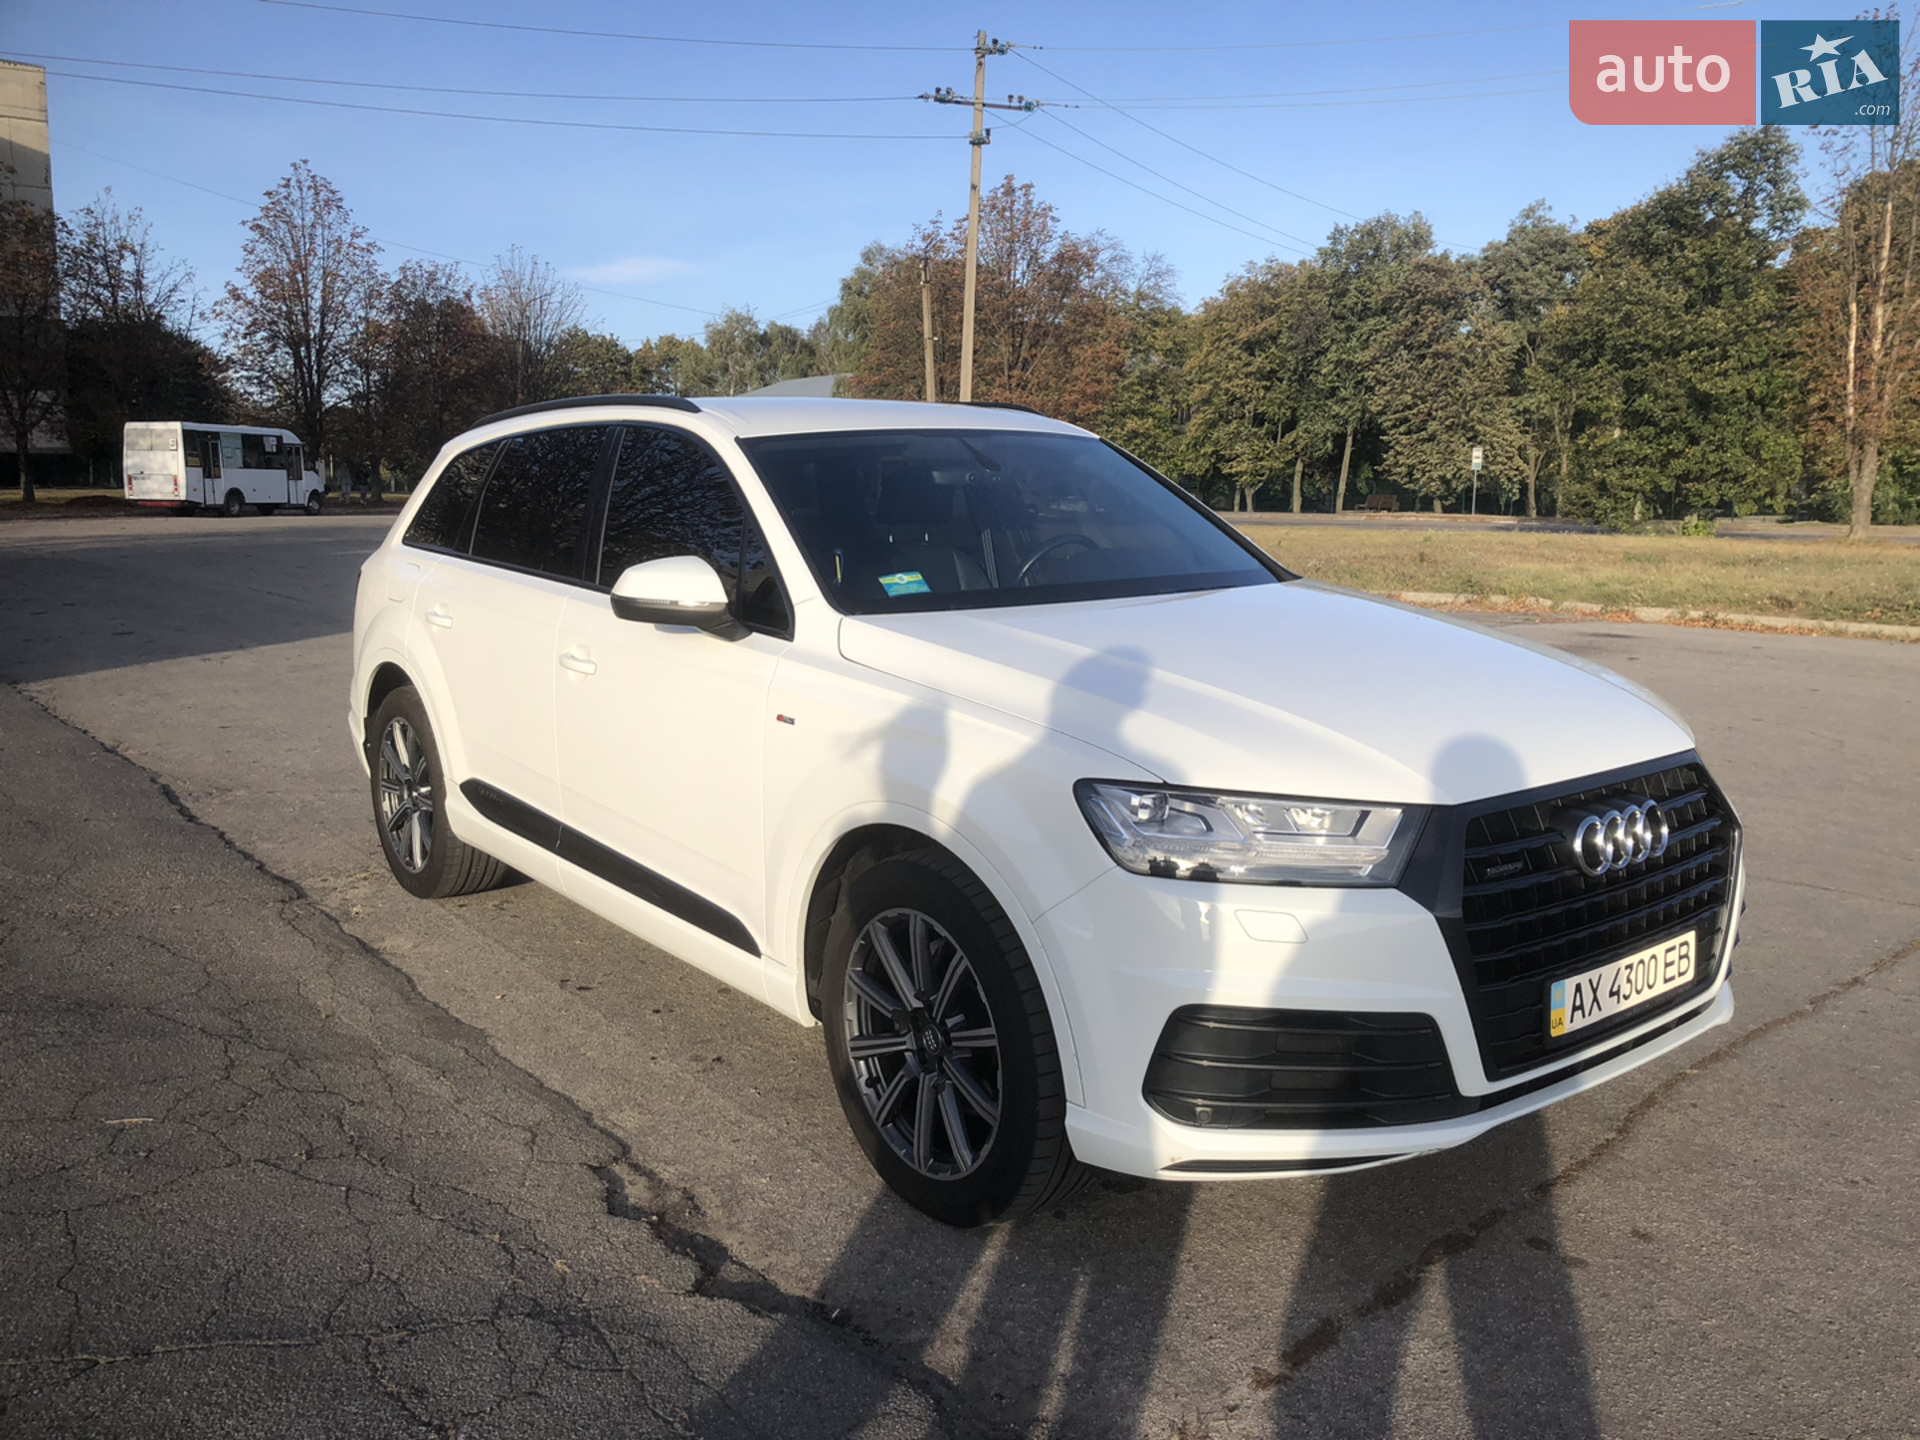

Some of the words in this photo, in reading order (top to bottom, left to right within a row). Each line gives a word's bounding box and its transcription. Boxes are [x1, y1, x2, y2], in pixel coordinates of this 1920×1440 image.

[1570, 973, 1602, 1024] AX
[1608, 953, 1658, 1005] 4300
[1663, 940, 1691, 984] EB
[1551, 1017, 1564, 1030] UA
